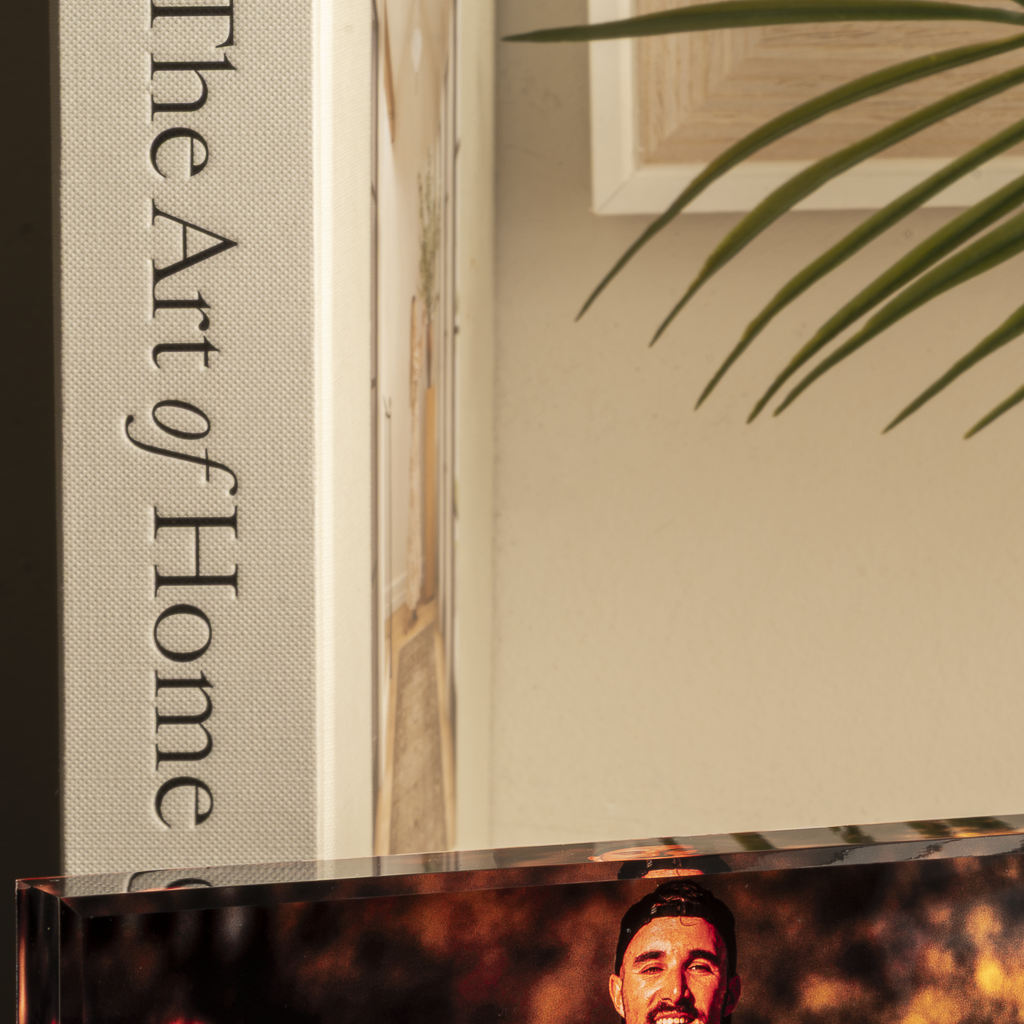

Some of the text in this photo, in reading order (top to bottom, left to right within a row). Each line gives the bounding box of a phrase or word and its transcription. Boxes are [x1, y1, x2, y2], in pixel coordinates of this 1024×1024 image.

[125, 0, 239, 829] The Art of Home
